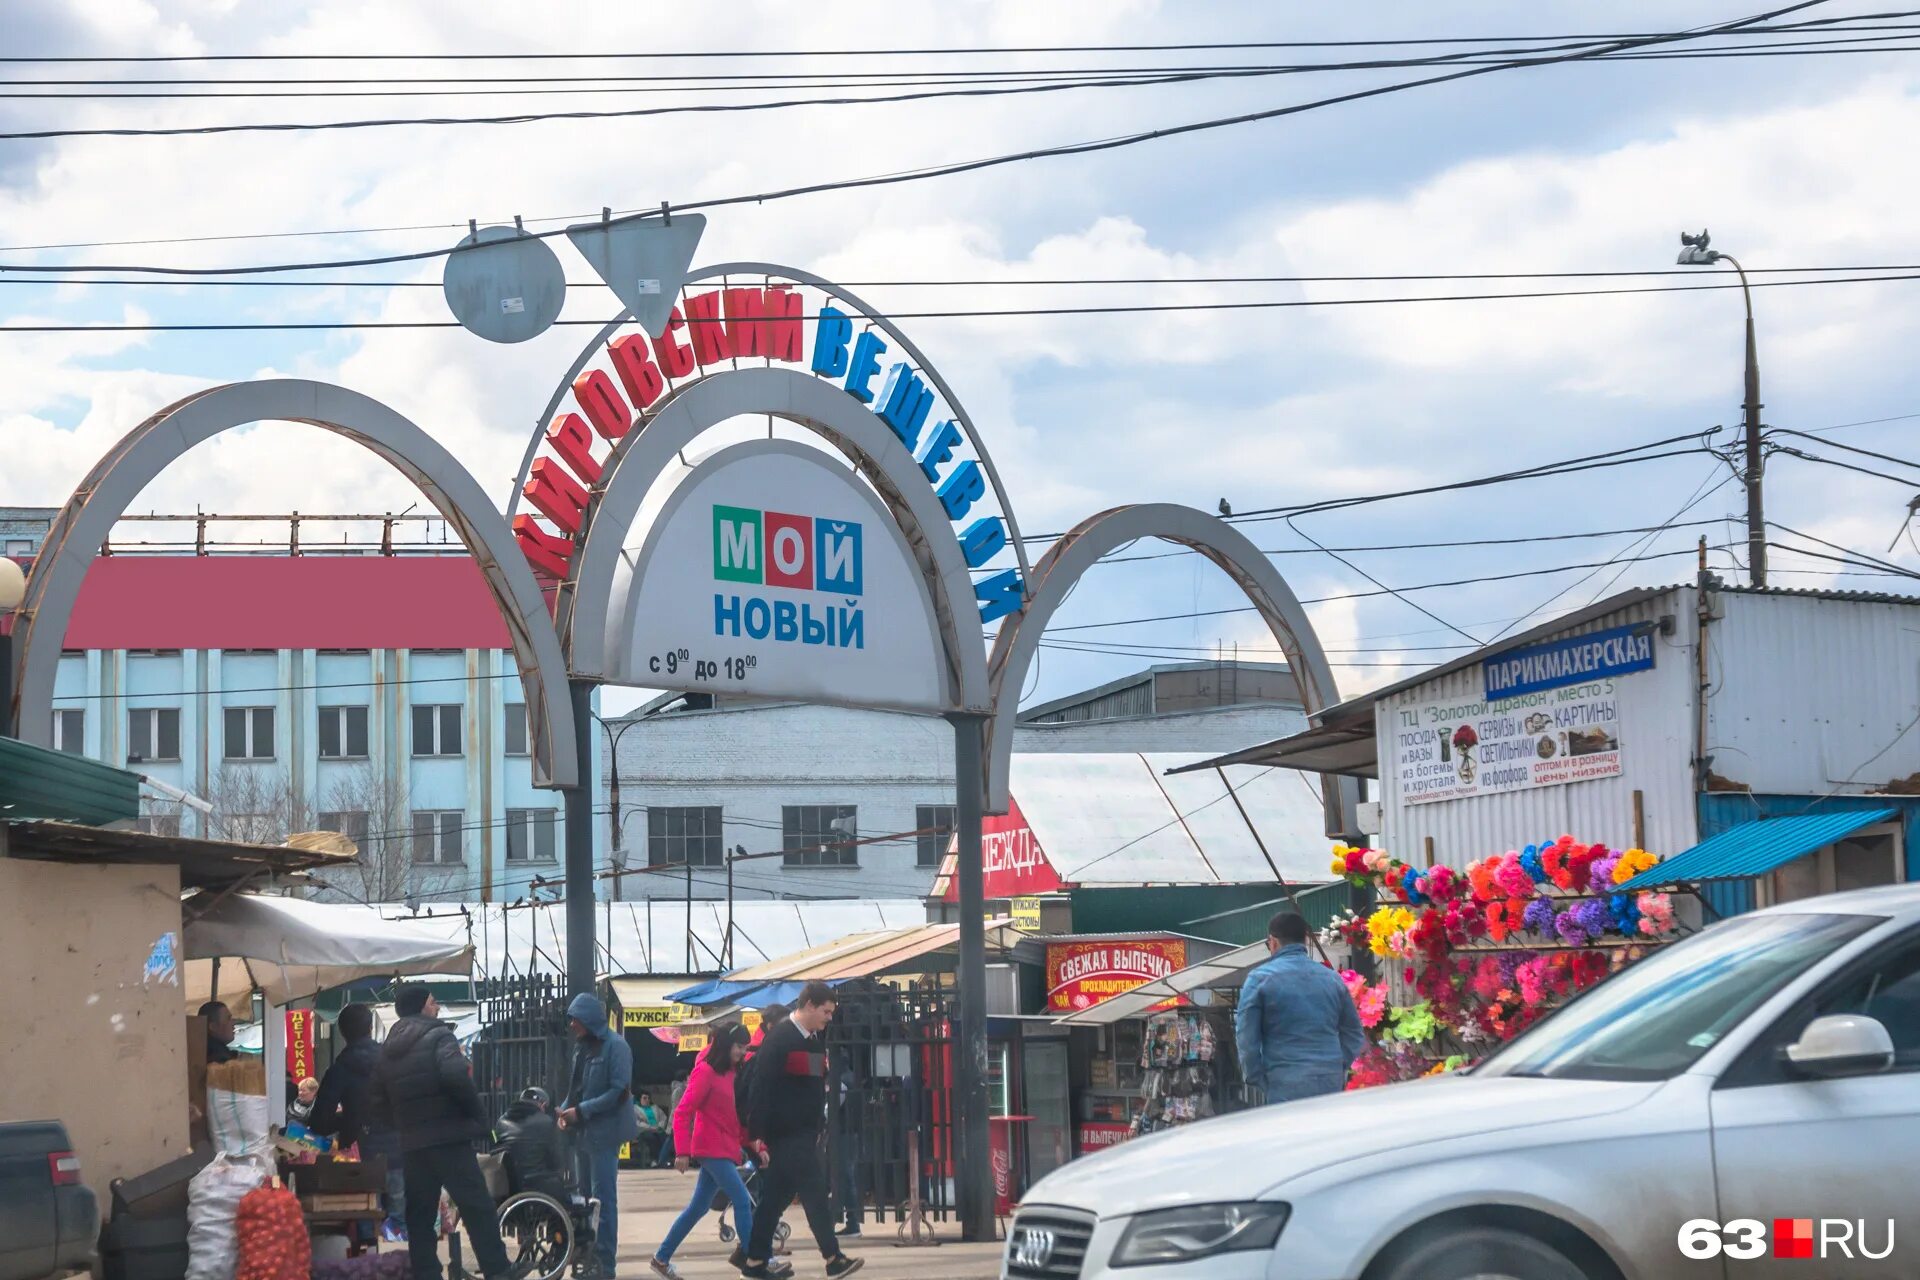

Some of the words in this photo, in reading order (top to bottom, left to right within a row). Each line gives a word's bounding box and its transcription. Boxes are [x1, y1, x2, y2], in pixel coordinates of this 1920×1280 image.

[512, 283, 803, 579] КИРОВСКИЙ
[720, 519, 854, 583] МОЙ
[714, 594, 864, 649] НОВЫЙ
[649, 656, 660, 673] с
[695, 660, 717, 681] до
[1488, 635, 1651, 691] ПАРИКМАХЕРСКАЯ
[1400, 709, 1419, 728] ТЦ
[1557, 684, 1601, 702] место
[1605, 678, 1614, 694] 5
[1554, 700, 1617, 728] КАРТИНЫ
[1400, 729, 1437, 747] ПОСУДА
[1479, 717, 1515, 741] СЕРВИЗЫ
[1517, 721, 1523, 735] и
[1402, 753, 1408, 763] и
[1409, 748, 1433, 763] ВАЗЫ
[1480, 738, 1536, 764] СВЕТИЛЬНИКИ
[1534, 759, 1561, 773] оптом
[1564, 759, 1569, 768] и
[1572, 758, 1577, 767] в
[1579, 752, 1618, 769] розницу
[1403, 770, 1414, 779] из
[1416, 763, 1454, 777] богемы
[1482, 772, 1491, 787] из
[1535, 772, 1569, 784] цены
[1572, 764, 1620, 777] низкие
[1404, 783, 1410, 793] и
[1413, 775, 1456, 794] хрусталя
[1060, 951, 1108, 982] СВЕЖАЯ
[1114, 949, 1171, 977] ВЫПЕЧКА
[1080, 979, 1151, 993] ПРОХЛАДИТЕЛЬН
[1054, 991, 1070, 1008] ЧАЙ
[292, 1011, 306, 1077] ДЕТСКАЯ
